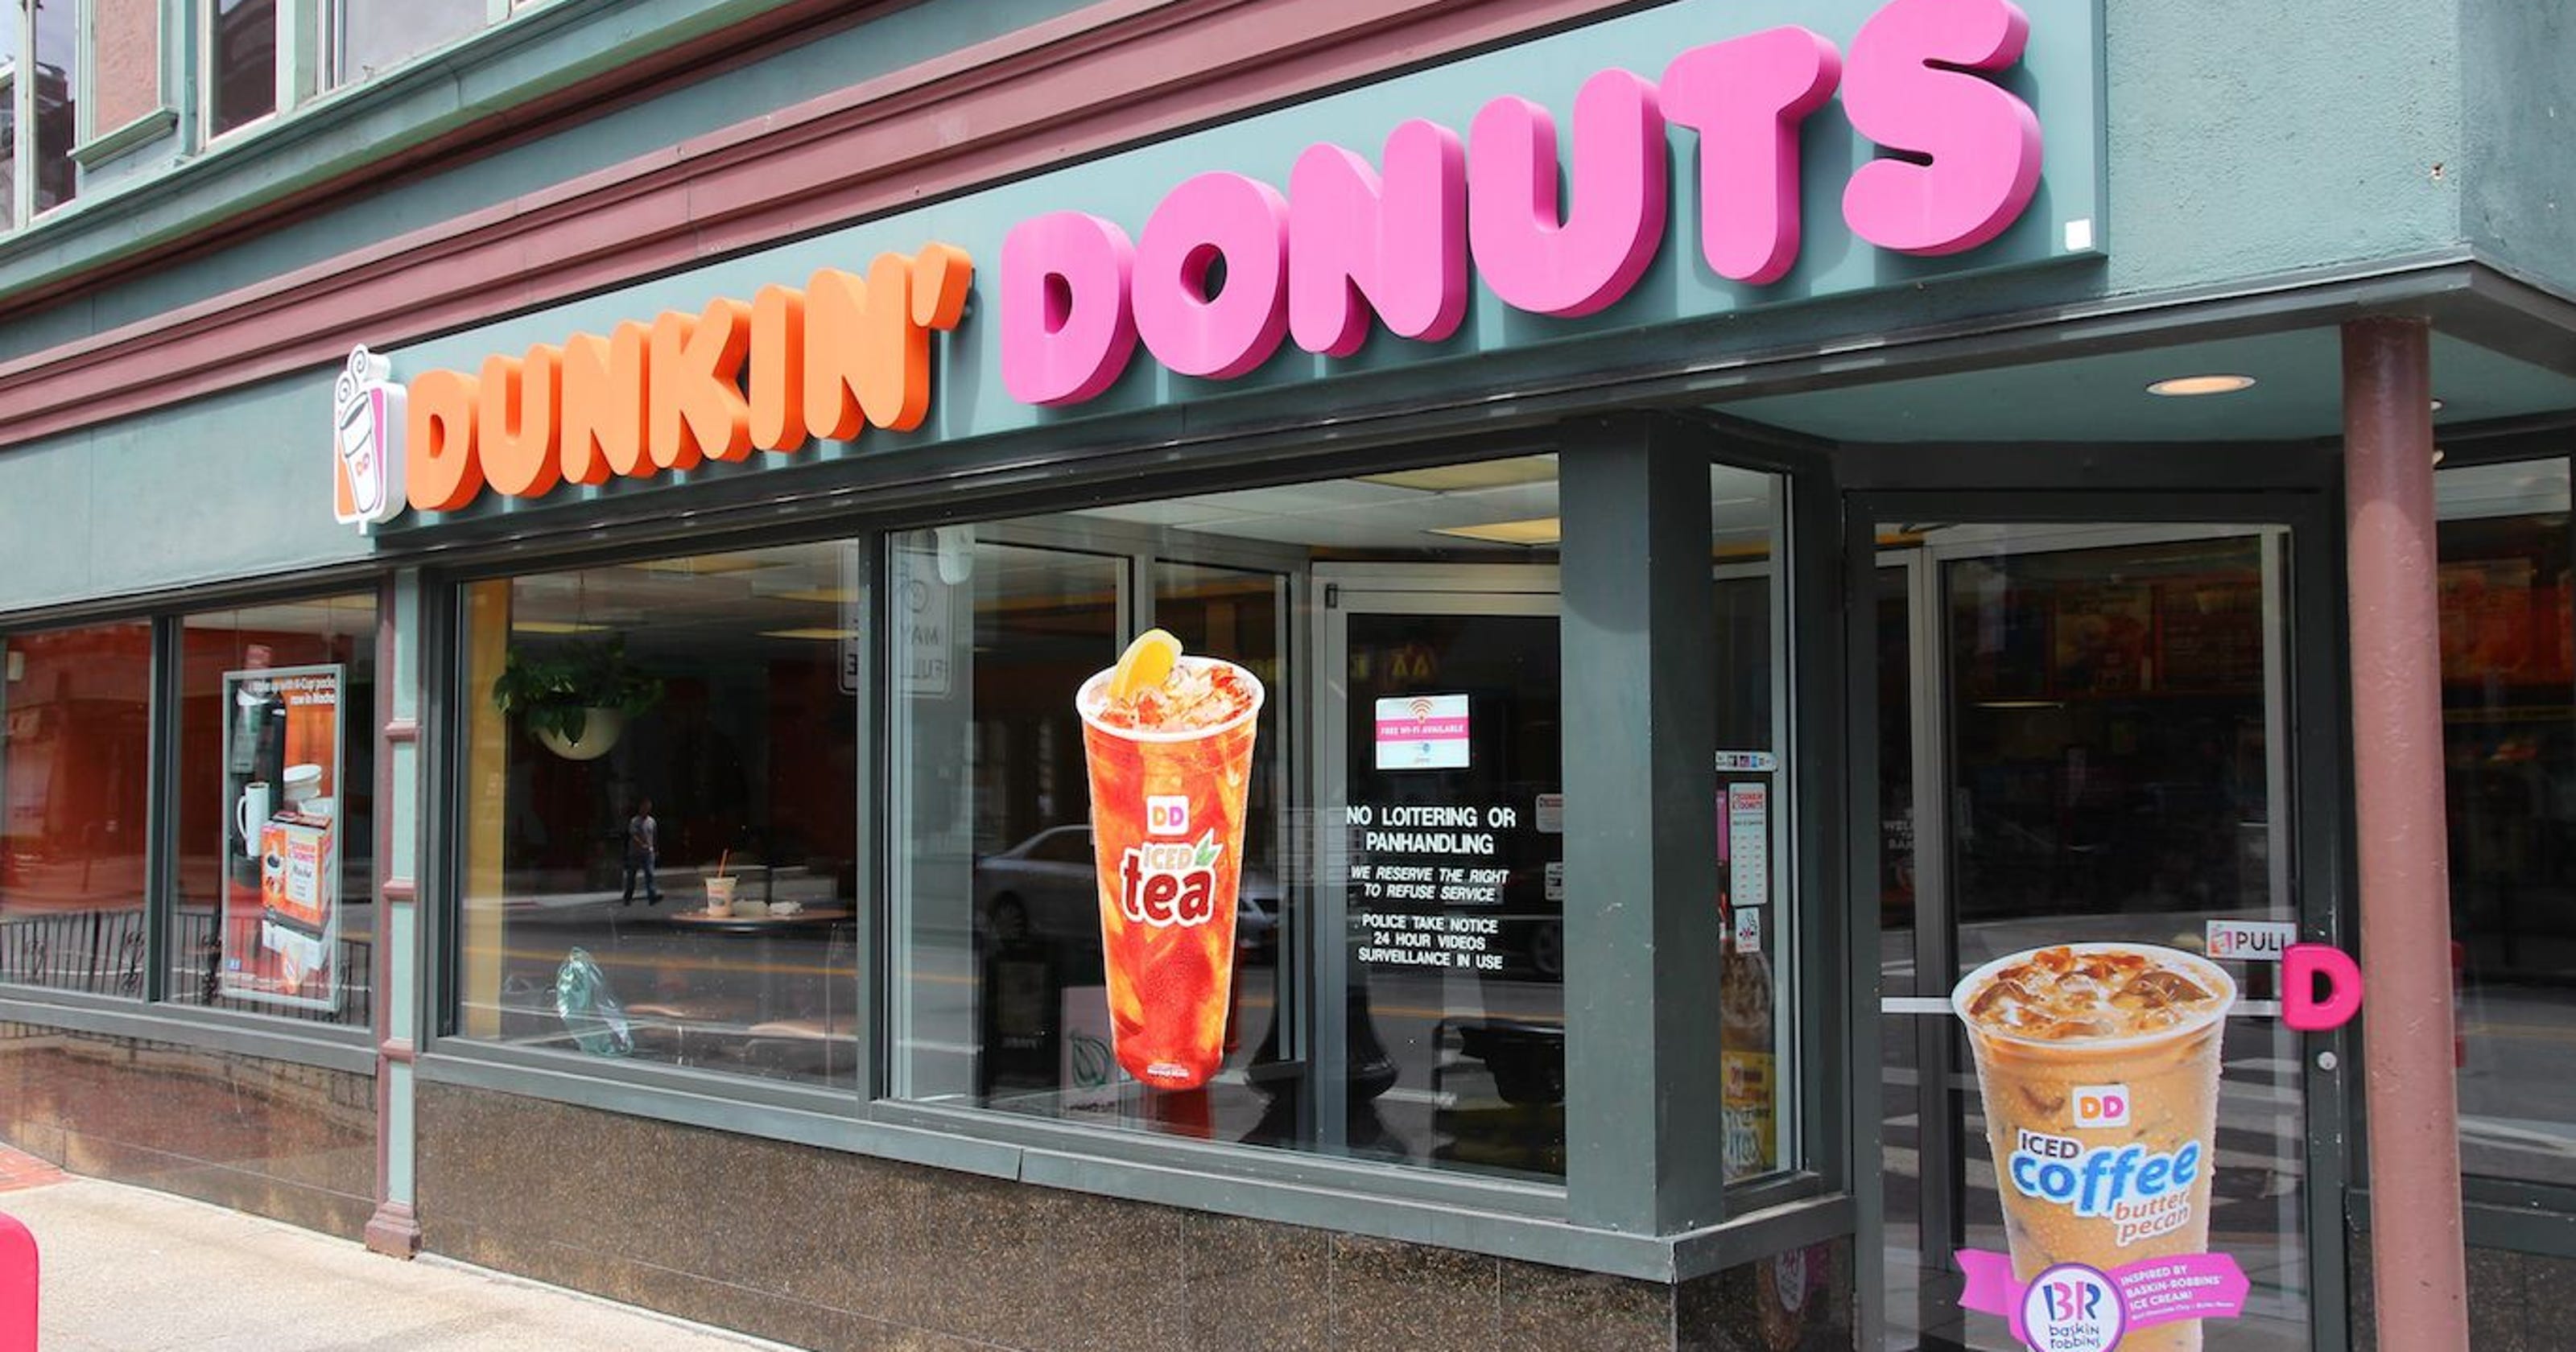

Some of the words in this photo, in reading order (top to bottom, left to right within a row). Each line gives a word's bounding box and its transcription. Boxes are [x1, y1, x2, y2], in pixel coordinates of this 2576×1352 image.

[405, 242, 974, 512] DUNKIN'
[1001, 0, 2042, 406] DONUTS
[1152, 806, 1184, 827] DD
[1346, 806, 1373, 826] NO
[1382, 806, 1478, 827] LOITERING
[1488, 807, 1516, 827] OR
[1366, 832, 1494, 854] PANHANDLING
[1143, 846, 1193, 870] ICED
[1351, 866, 1371, 880] WE
[1376, 867, 1433, 881] RESERVE
[1439, 868, 1464, 882] THE
[1469, 870, 1509, 884] RIGHT
[1124, 854, 1212, 921] tea
[1364, 884, 1381, 897] TO
[1386, 885, 1435, 900] REFUSE
[1440, 887, 1496, 902] SERVICE
[1362, 914, 1406, 929] POLICE
[1412, 917, 1444, 931] TAKE
[1451, 919, 1498, 934] NOTICE
[1373, 932, 1390, 945] 24
[1396, 934, 1431, 947] HOUR
[1438, 936, 1486, 950] VIDEOS
[1358, 946, 1450, 967] SURVEILLANCE
[1456, 953, 1470, 967] IN
[1476, 954, 1503, 970] USE
[2281, 944, 2363, 1030] D
[2080, 1095, 2124, 1119] DD
[2022, 1132, 2079, 1159] ICED
[2013, 1142, 2199, 1211] coffee
[2116, 1193, 2187, 1221] butter
[2121, 1207, 2189, 1243] pecan
[2121, 1267, 2171, 1285] INSPIRED
[2173, 1265, 2187, 1276] BY
[2043, 1281, 2101, 1321] BR
[2130, 1299, 2147, 1309] ICE
[2149, 1292, 2194, 1307] CREAM!
[2049, 1324, 2099, 1337] baskin
[2050, 1336, 2100, 1350] robbins
